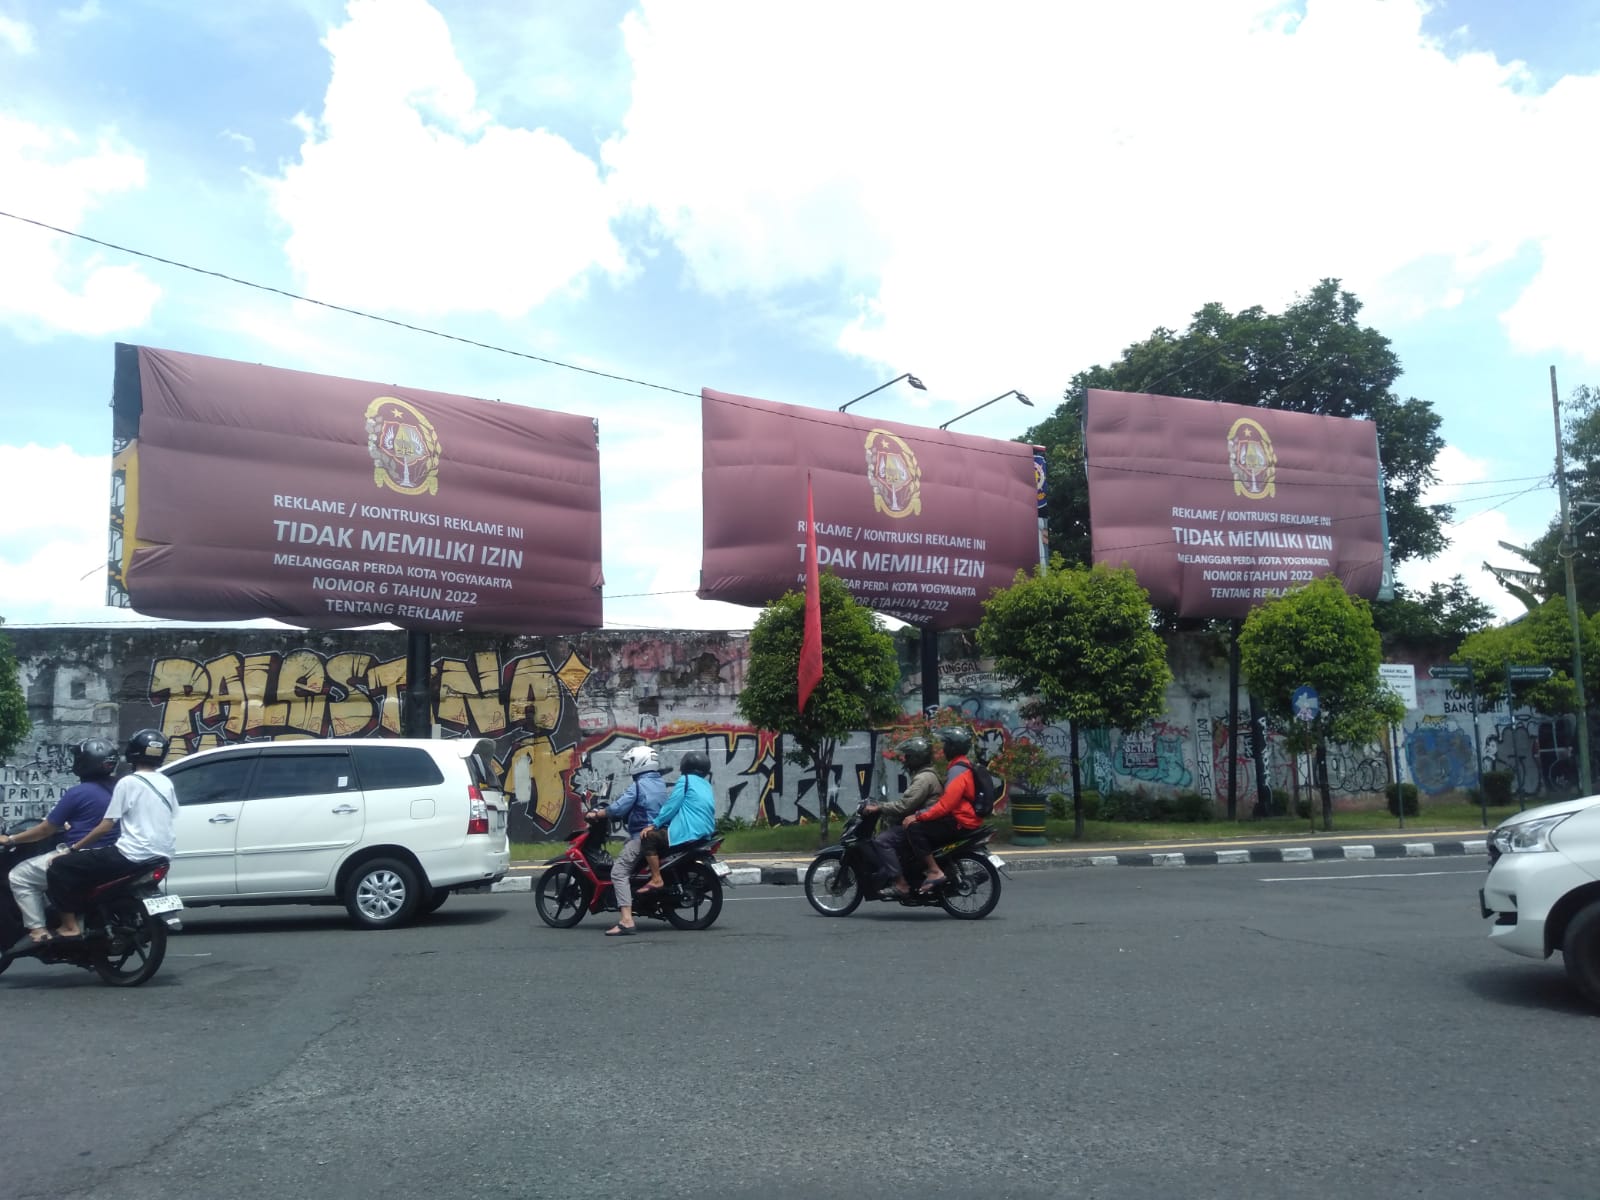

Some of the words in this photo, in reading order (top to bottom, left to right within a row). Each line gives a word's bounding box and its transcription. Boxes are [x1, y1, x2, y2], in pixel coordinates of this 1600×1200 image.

[274, 494, 345, 515] REKLAME
[350, 503, 357, 518] /
[361, 505, 440, 526] KONTRUKSI
[444, 517, 503, 536] REKLAME
[507, 527, 523, 539] INI
[1172, 507, 1218, 520] REKLAME
[1220, 510, 1225, 522] /
[1227, 511, 1277, 523] KONTRUKSI
[1280, 514, 1319, 525] REKLAME
[274, 520, 354, 548] TIDAK
[361, 530, 474, 563] MEMILIKI
[481, 546, 523, 569] IZIN
[798, 521, 852, 538] RKLAME
[854, 527, 861, 541] /
[864, 529, 922, 544] KONTRUKSI
[926, 534, 971, 549] REKLAME
[974, 538, 986, 551] INI
[1172, 527, 1225, 546] TIDAK
[1228, 531, 1303, 549] MEMILIKI
[1306, 534, 1332, 551] IZIN
[274, 553, 360, 572] MELANGGAR
[363, 562, 403, 575] PERDA
[407, 567, 437, 580] KOTA
[441, 571, 512, 589] YOGYAKARTA
[797, 544, 857, 569] TDAK
[863, 552, 948, 574] MEMILIKI
[954, 558, 985, 578] IZIN
[1178, 553, 1232, 565] MELANGGAR
[1233, 556, 1256, 565] PERDA
[1259, 556, 1281, 565] KOTA
[1284, 557, 1330, 567] YOGYAKARTA
[1203, 570, 1241, 581] NOMOR
[1243, 571, 1248, 580] 6
[1249, 571, 1287, 580] TAHUN
[1291, 571, 1313, 581] 2022
[312, 576, 375, 593] NOMOR
[379, 582, 388, 594] 6
[392, 583, 441, 600] TAHUN
[445, 589, 477, 604] 2022
[863, 581, 888, 592] PERDA
[892, 582, 917, 593] KOTA
[921, 583, 976, 597] YOGYAKARTA
[1211, 588, 1250, 598] TENTANG
[326, 599, 393, 614] TENTANG
[397, 605, 464, 623] REKLAME
[880, 597, 920, 608] TAHUN
[923, 600, 949, 611] 2022
